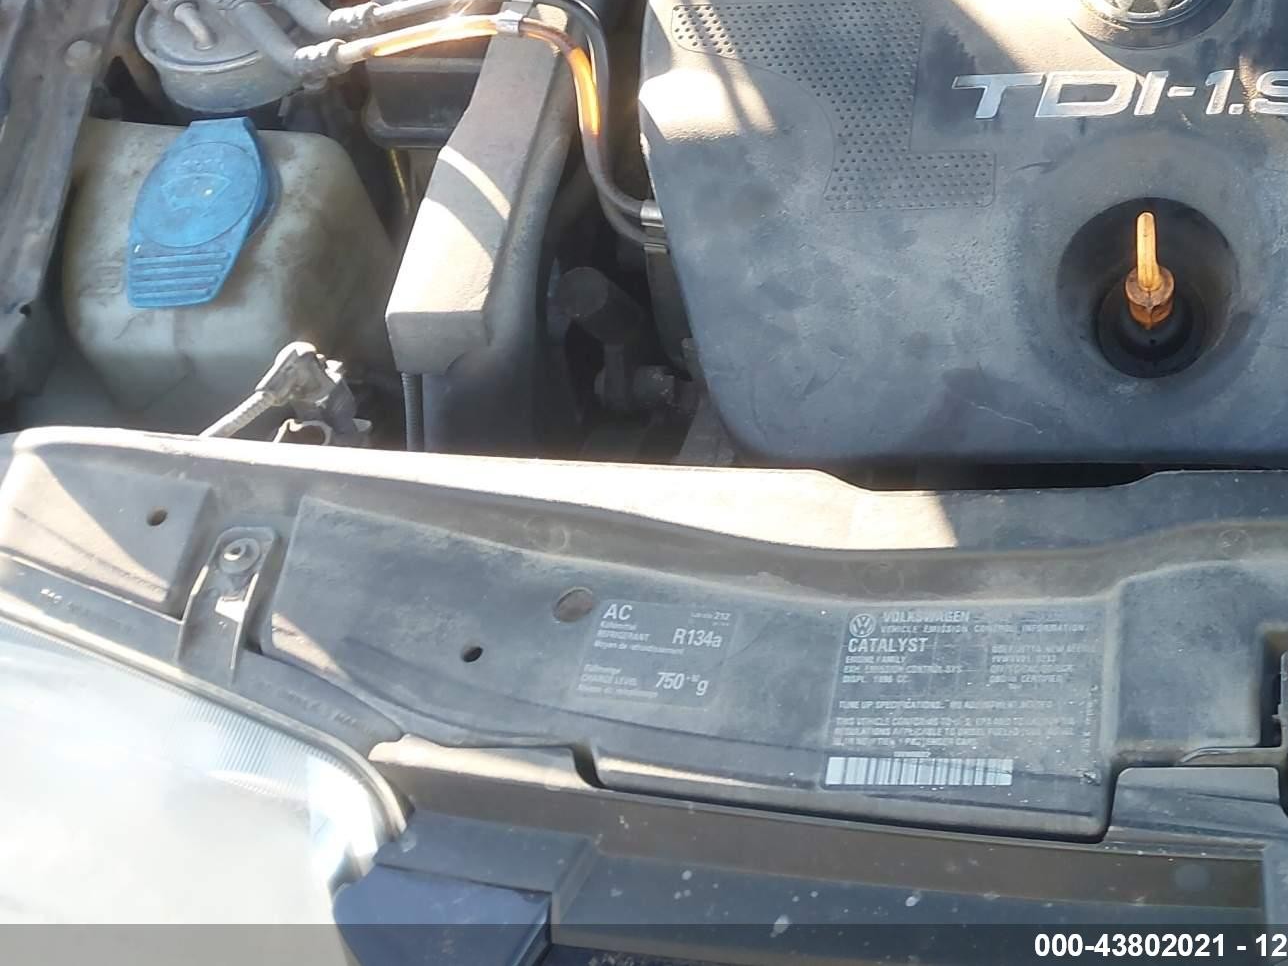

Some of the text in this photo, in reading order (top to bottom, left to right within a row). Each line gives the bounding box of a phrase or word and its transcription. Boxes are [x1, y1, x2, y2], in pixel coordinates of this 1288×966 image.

[602, 603, 633, 621] AC
[672, 628, 723, 648] R134a
[847, 638, 929, 653] CATALYST
[655, 672, 686, 690] 750
[695, 679, 709, 696] g
